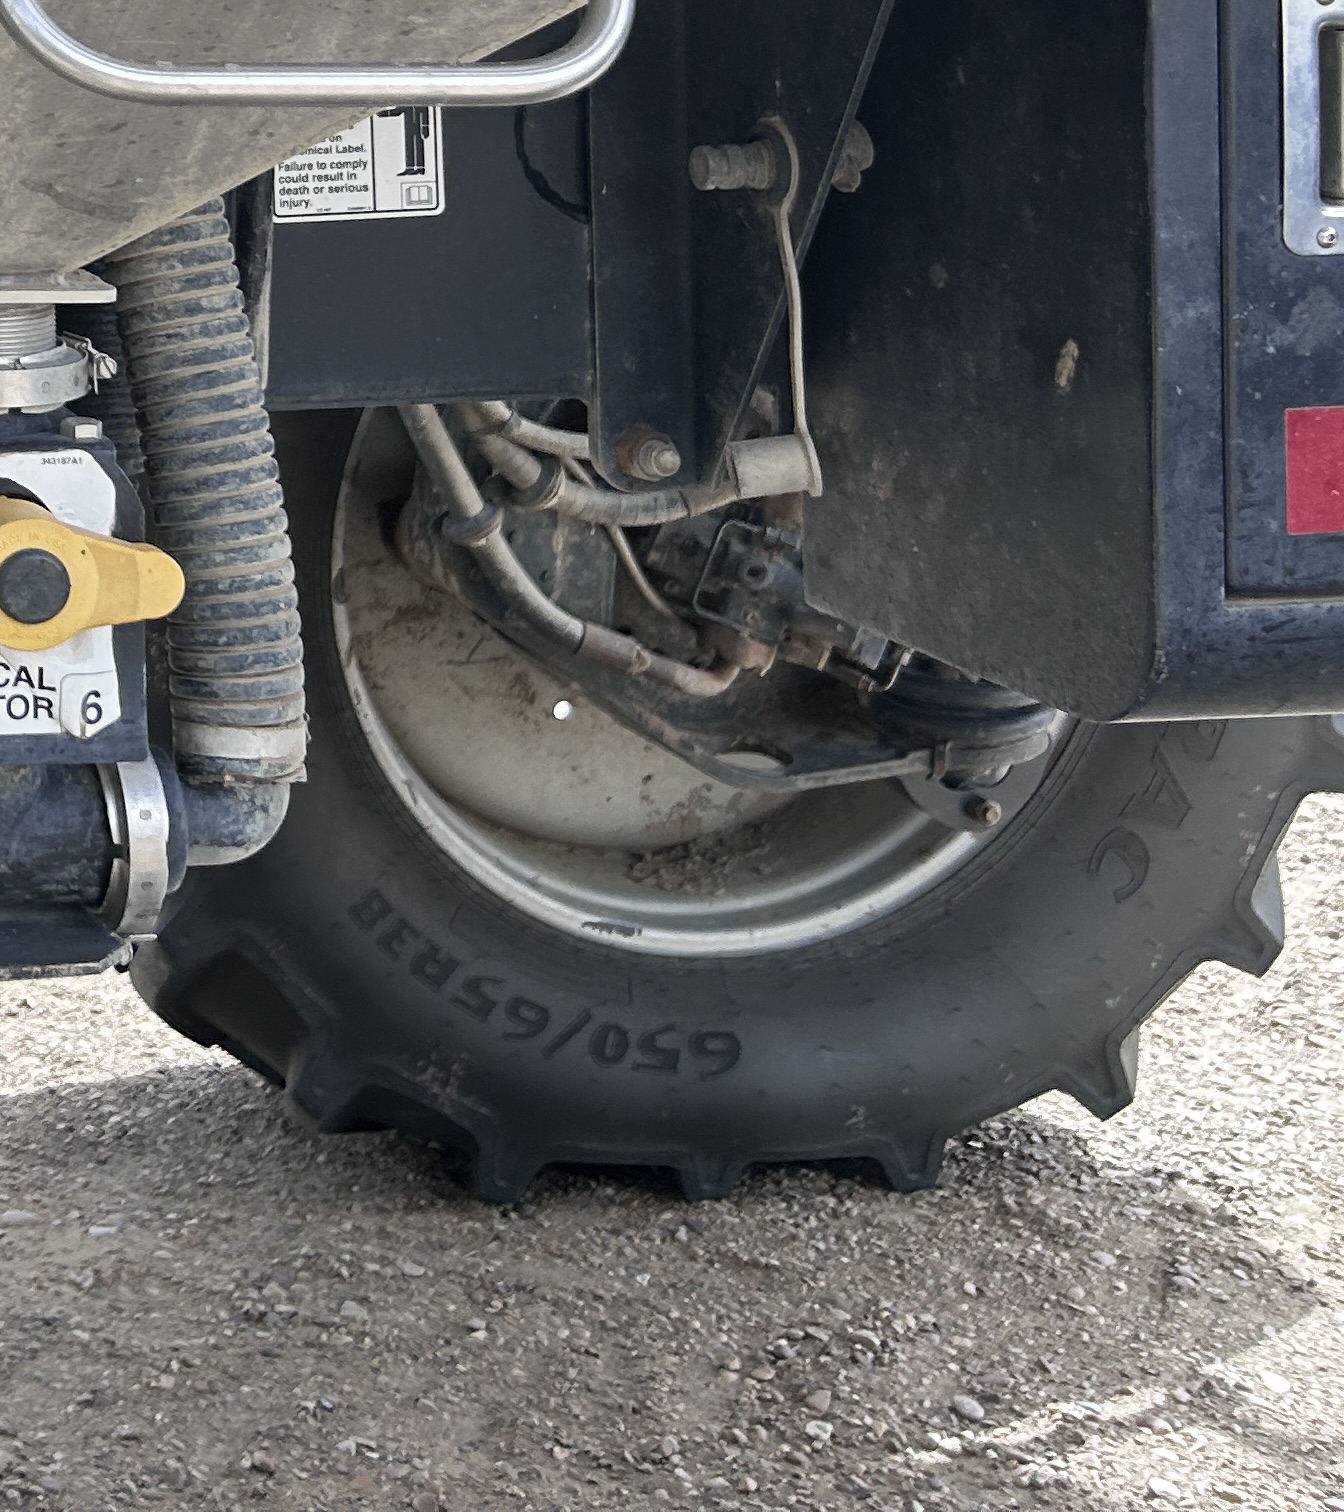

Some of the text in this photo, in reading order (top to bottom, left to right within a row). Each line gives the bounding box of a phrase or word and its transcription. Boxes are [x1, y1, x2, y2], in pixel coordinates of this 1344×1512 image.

[278, 159, 367, 172] Failure to comply
[278, 171, 357, 184] could result in
[279, 183, 368, 196] death or serious
[81, 689, 103, 725] 6
